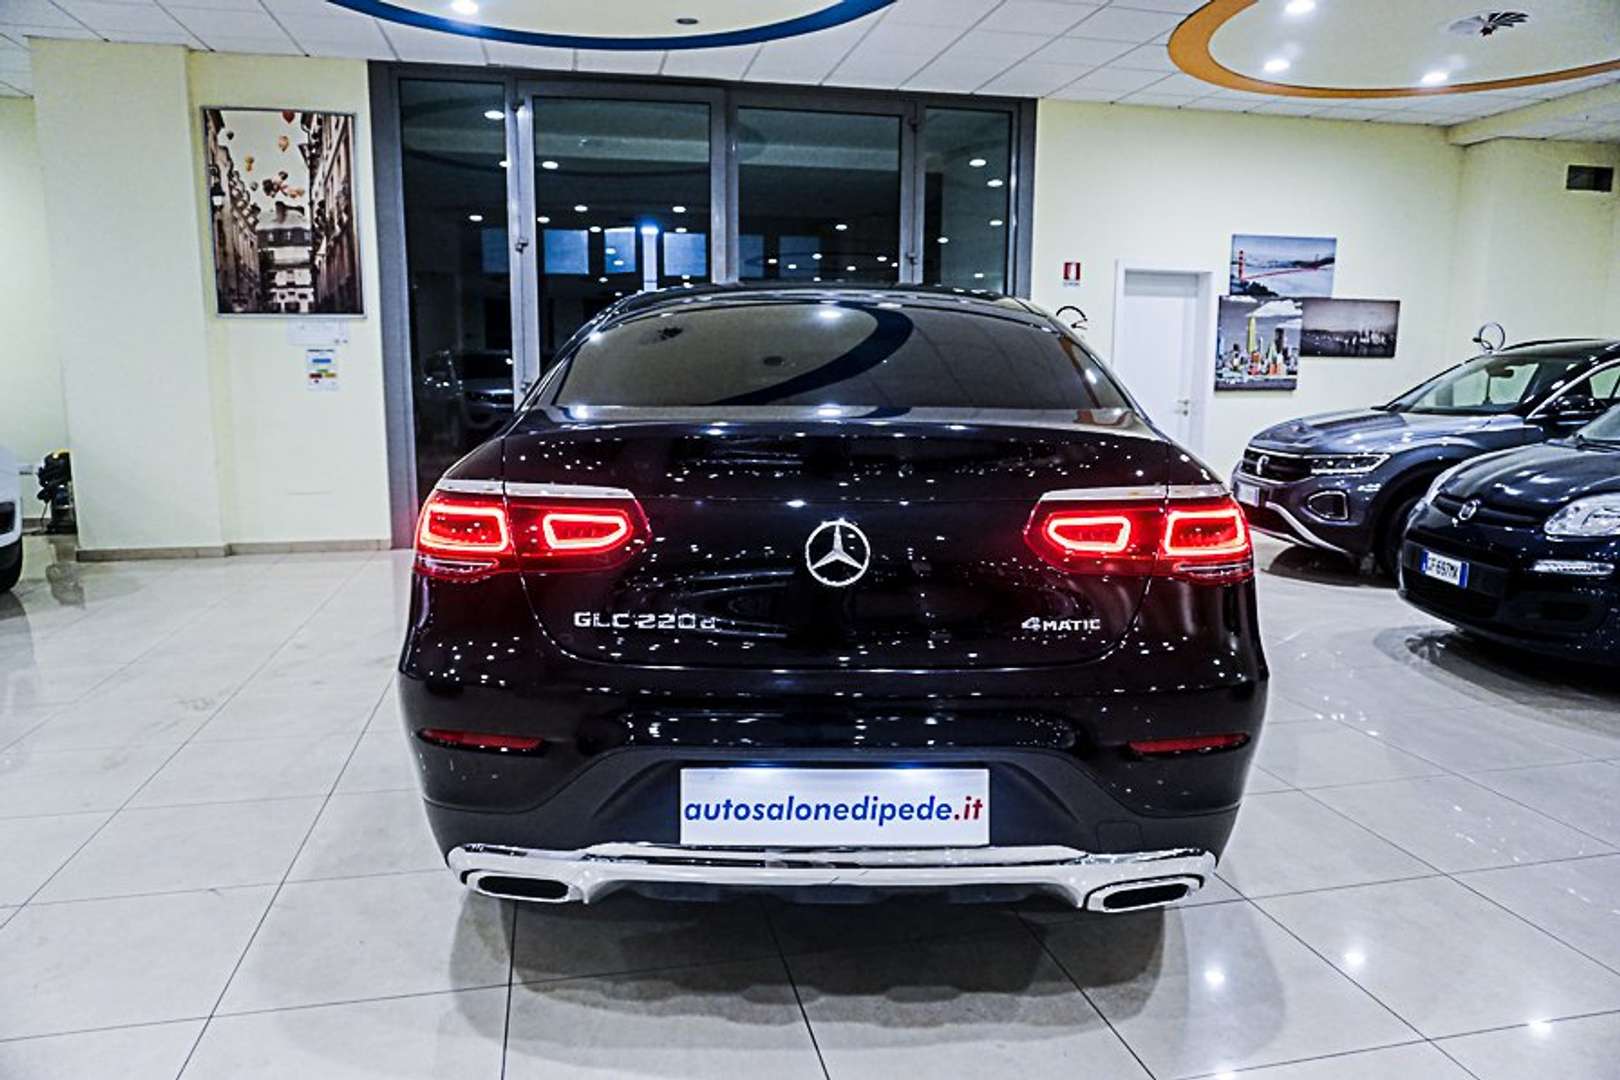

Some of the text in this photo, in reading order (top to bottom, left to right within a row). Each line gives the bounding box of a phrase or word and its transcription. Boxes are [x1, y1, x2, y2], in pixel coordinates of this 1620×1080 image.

[573, 612, 630, 628] GLC
[1021, 617, 1101, 631] 4MATIC
[684, 796, 983, 827] autosalonedipede.it
